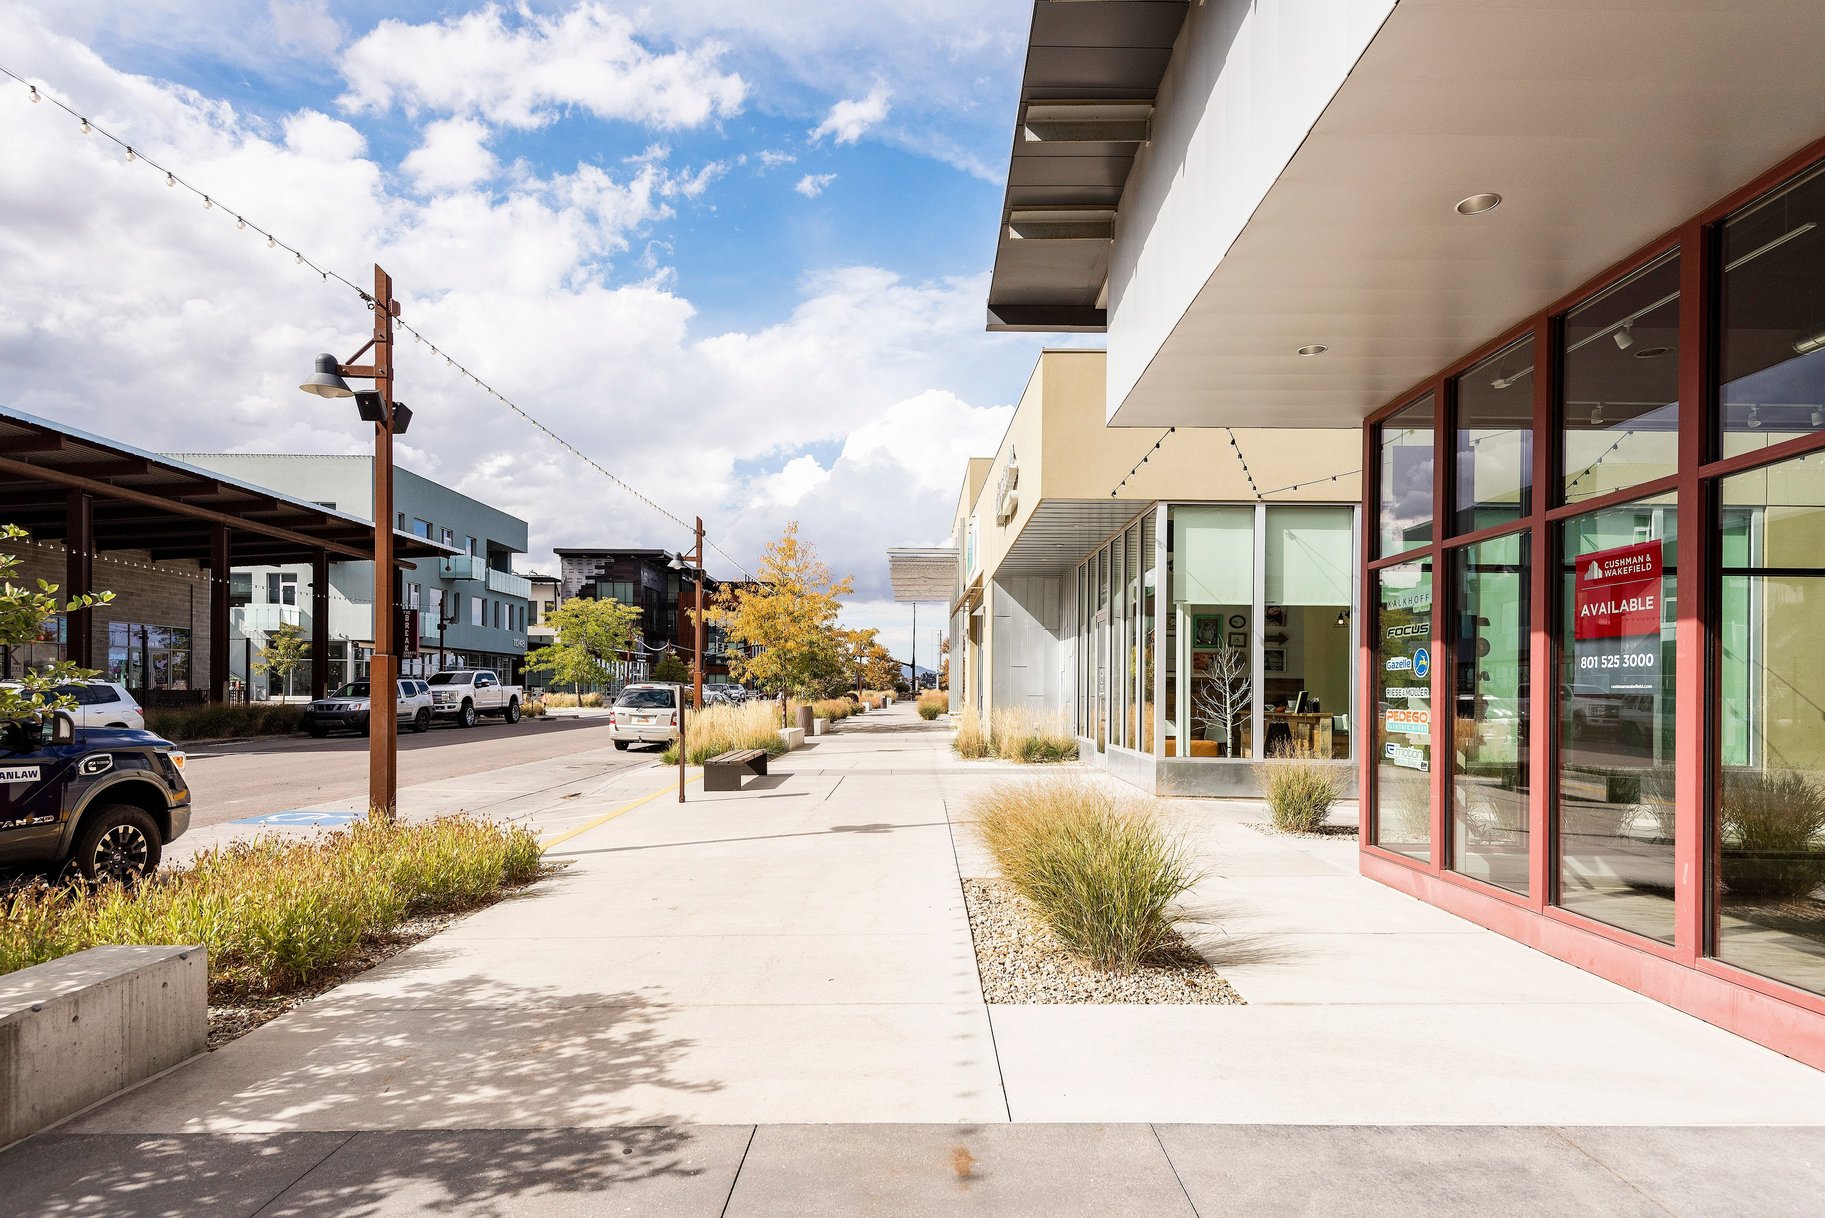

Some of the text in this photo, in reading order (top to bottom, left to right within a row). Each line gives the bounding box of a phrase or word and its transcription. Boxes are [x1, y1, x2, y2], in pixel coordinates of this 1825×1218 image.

[1604, 553, 1652, 568] CUSHMAN &
[1604, 563, 1652, 577] WAKEFIELD
[1387, 593, 1429, 608] KALKHOFF
[1580, 596, 1654, 617] AVAILABLE
[1387, 623, 1429, 638] FOCUS
[1387, 660, 1410, 669] Gazelle
[1580, 653, 1654, 669] 801 525 3000
[1387, 711, 1427, 723] PEDEGO
